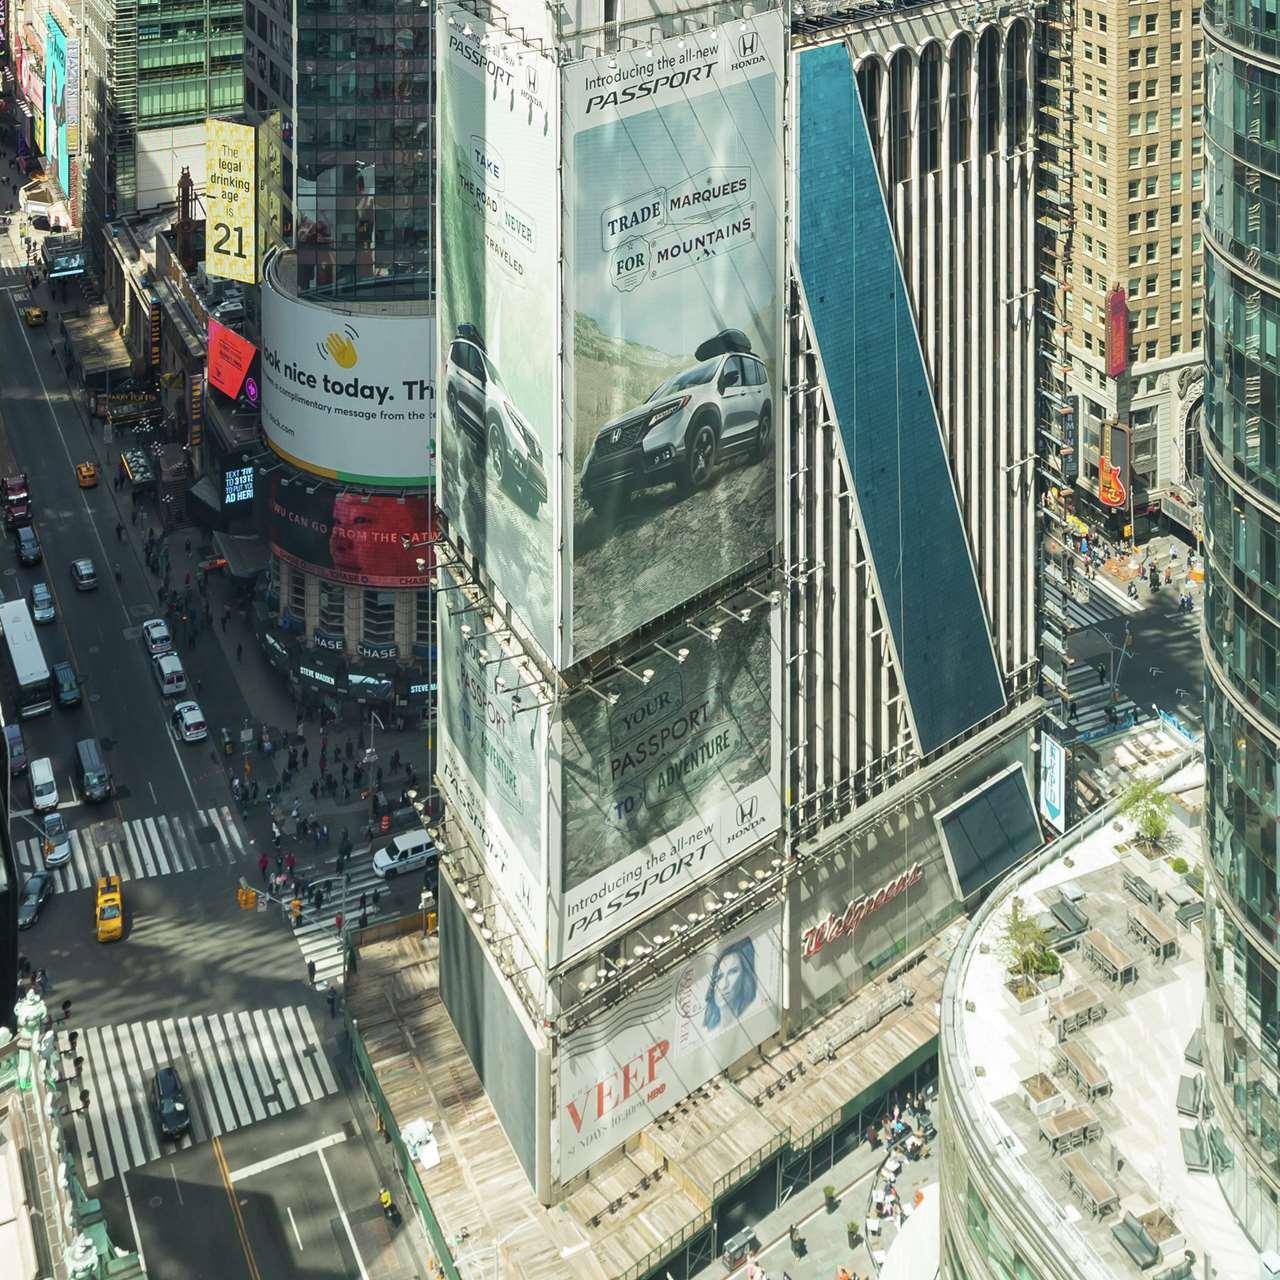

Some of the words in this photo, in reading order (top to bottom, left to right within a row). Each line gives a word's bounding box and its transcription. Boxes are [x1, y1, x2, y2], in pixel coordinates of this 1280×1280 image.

[448, 35, 515, 87] PASSPORT
[585, 62, 654, 91] Introducing
[657, 55, 676, 72] the
[678, 44, 719, 65] all-new
[730, 55, 766, 71] HONDA
[585, 62, 719, 114] PASSPORT
[218, 158, 242, 174] legal
[222, 144, 239, 158] The
[475, 149, 500, 179] TAKE
[210, 173, 250, 193] drinking
[221, 190, 239, 203] age
[459, 174, 474, 195] THE
[476, 187, 498, 213] ROAD
[607, 201, 661, 237] TRADE
[670, 178, 747, 211] MARQUEES
[213, 222, 247, 259] 21
[505, 211, 532, 244] NEVER
[616, 252, 645, 276] FOR
[657, 217, 751, 264] MOUNTAINS
[485, 236, 524, 276] TRAVELED
[284, 362, 317, 389] nice
[323, 374, 394, 405] today.
[402, 379, 436, 401] Th
[334, 405, 377, 420] message
[380, 410, 405, 420] from
[408, 411, 425, 420] the
[225, 493, 236, 504] AD
[288, 512, 308, 528] CAN
[332, 526, 367, 541] FROM
[371, 532, 397, 543] THE
[356, 645, 397, 659] CHASE
[410, 683, 429, 693] STEVE
[622, 691, 671, 730] YOUR
[611, 700, 710, 782] PASSPORT
[481, 731, 518, 796] ADVENTURE
[614, 796, 634, 820] TO
[657, 729, 730, 793] ADVENTURE
[727, 816, 766, 844] HONDA
[567, 864, 643, 917] Introducing
[646, 851, 667, 870] the
[670, 824, 714, 856] all-new
[568, 839, 715, 942] PASSPORT
[800, 862, 923, 960] Walgreens
[566, 1039, 670, 1134] VEEP
[645, 1082, 667, 1105] HBO
